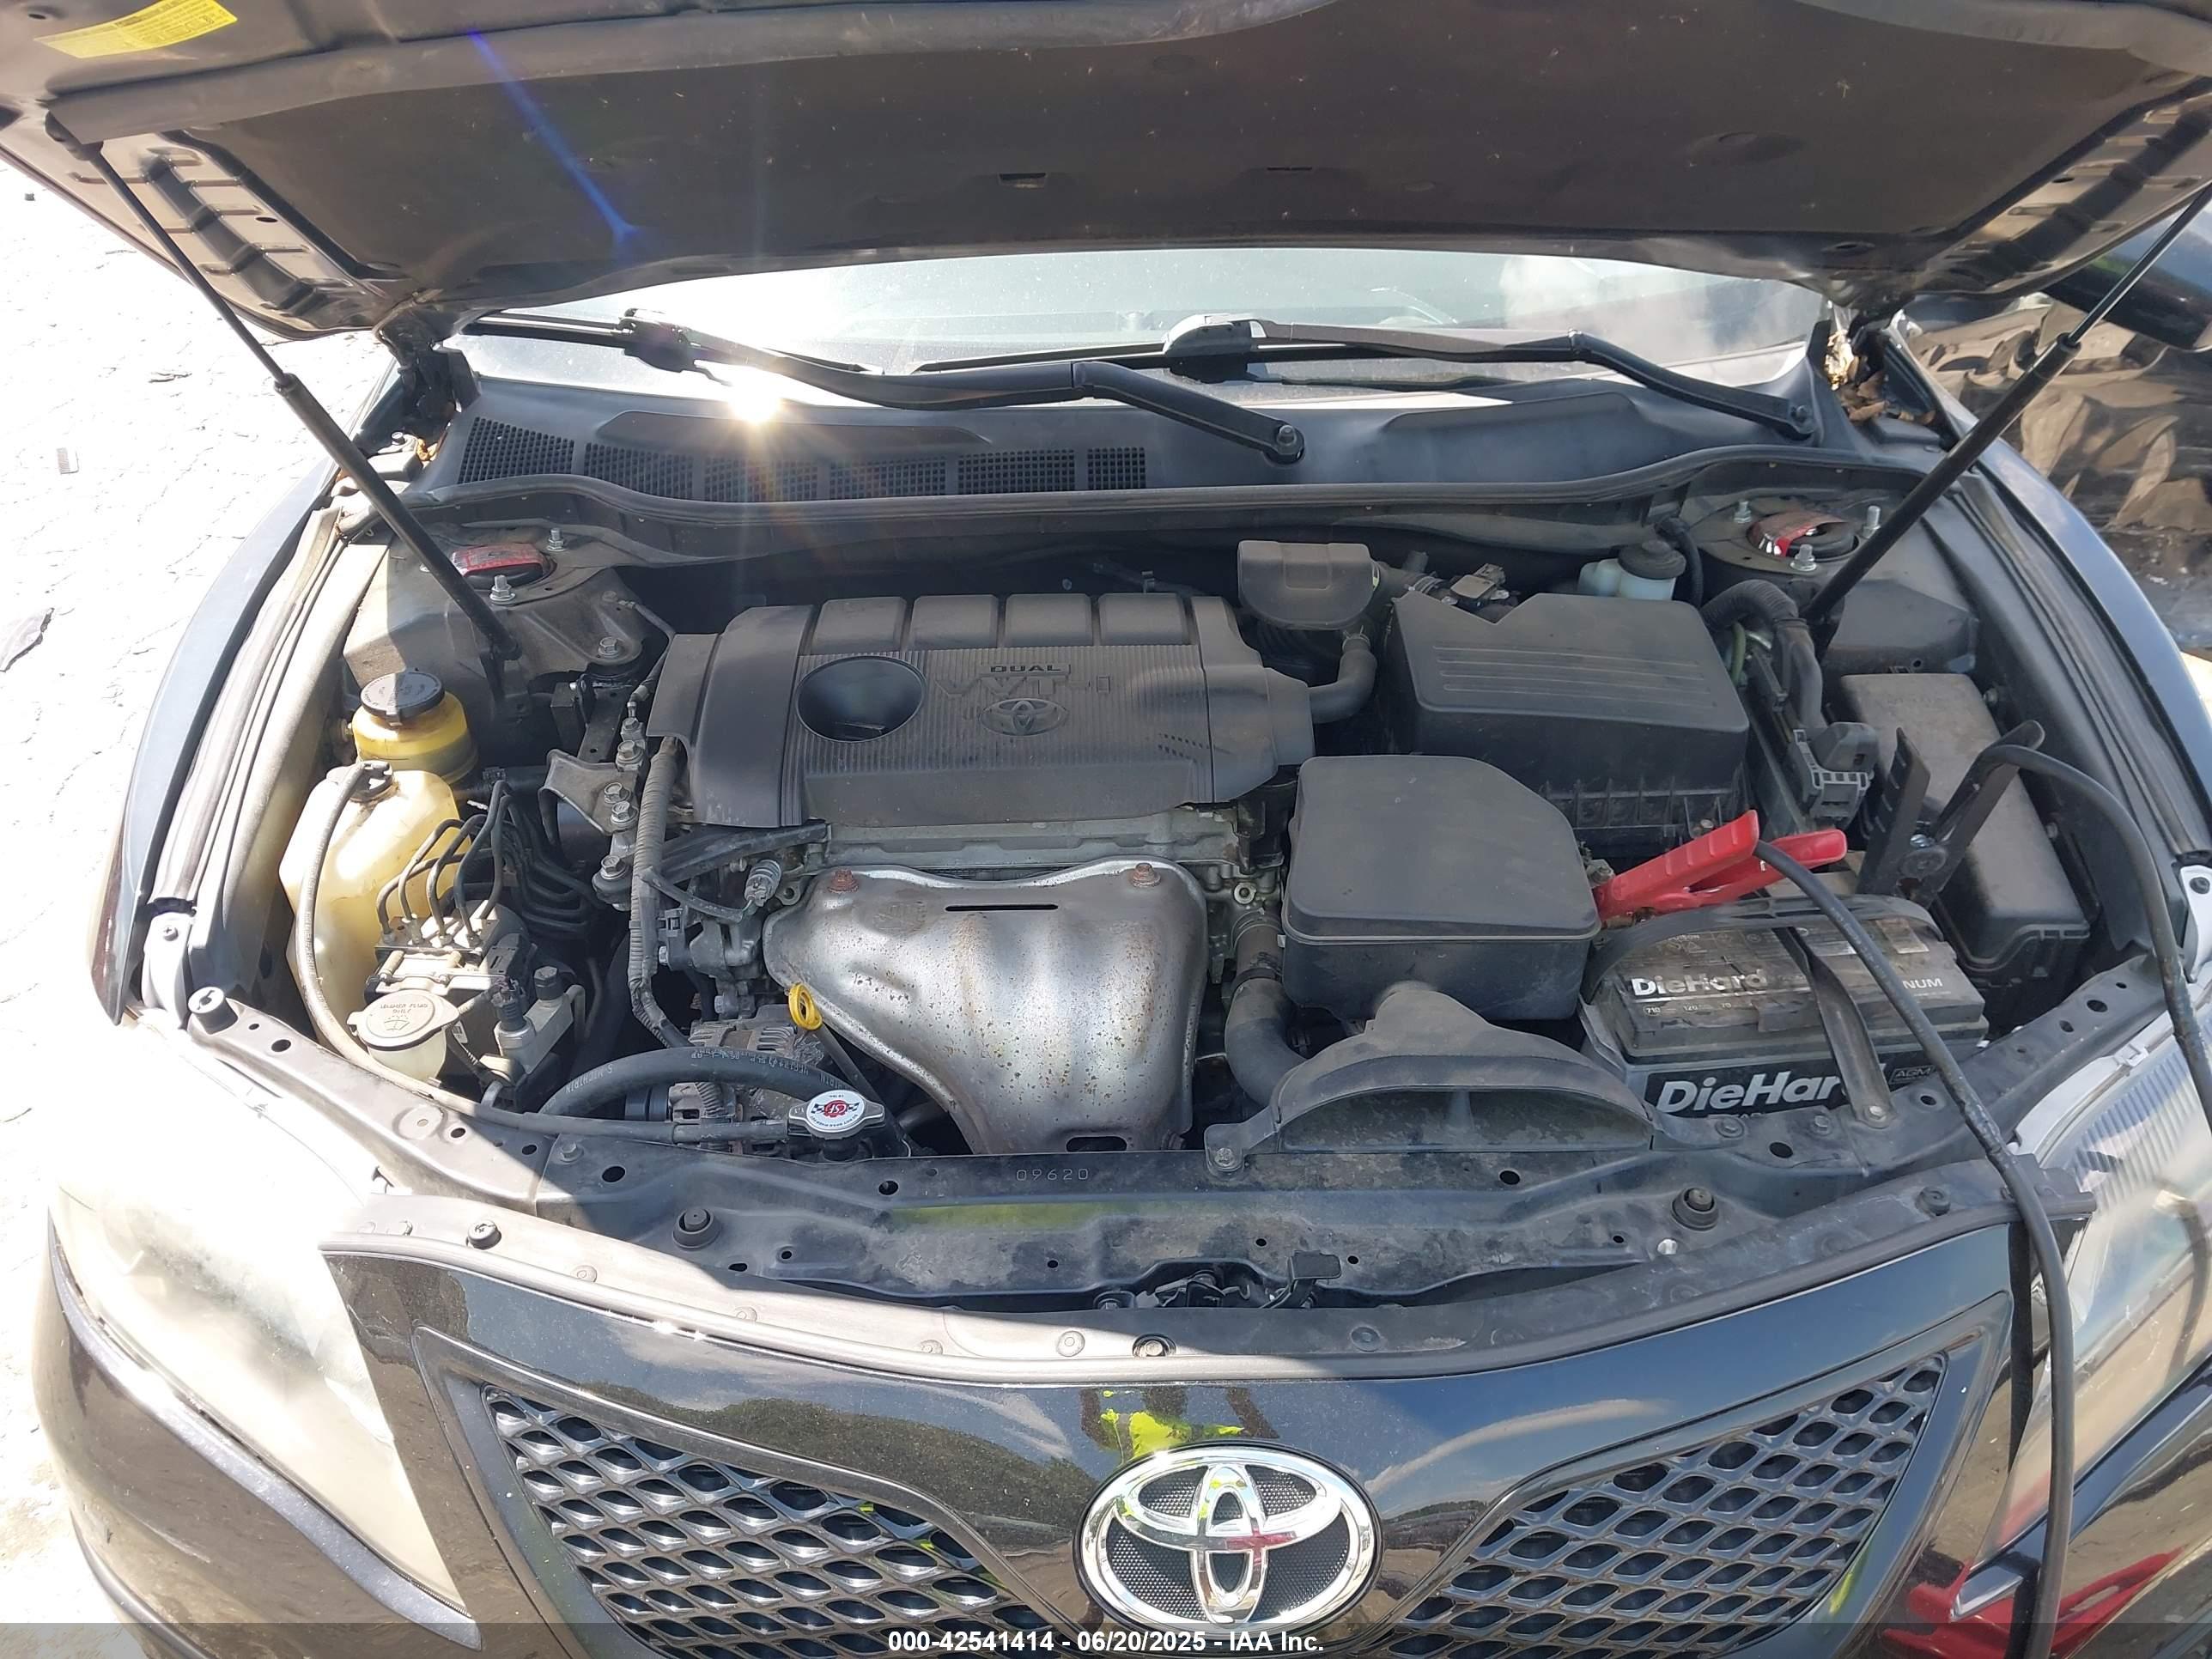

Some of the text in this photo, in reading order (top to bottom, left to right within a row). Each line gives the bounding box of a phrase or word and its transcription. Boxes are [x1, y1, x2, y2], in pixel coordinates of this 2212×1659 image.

[990, 665, 1062, 673] DUAL
[1632, 969, 1768, 996] DieHard
[1656, 1067, 1931, 1114] DieHar AGM
[828, 1103, 847, 1114] CSF
[1016, 1169, 1089, 1182] 09620
